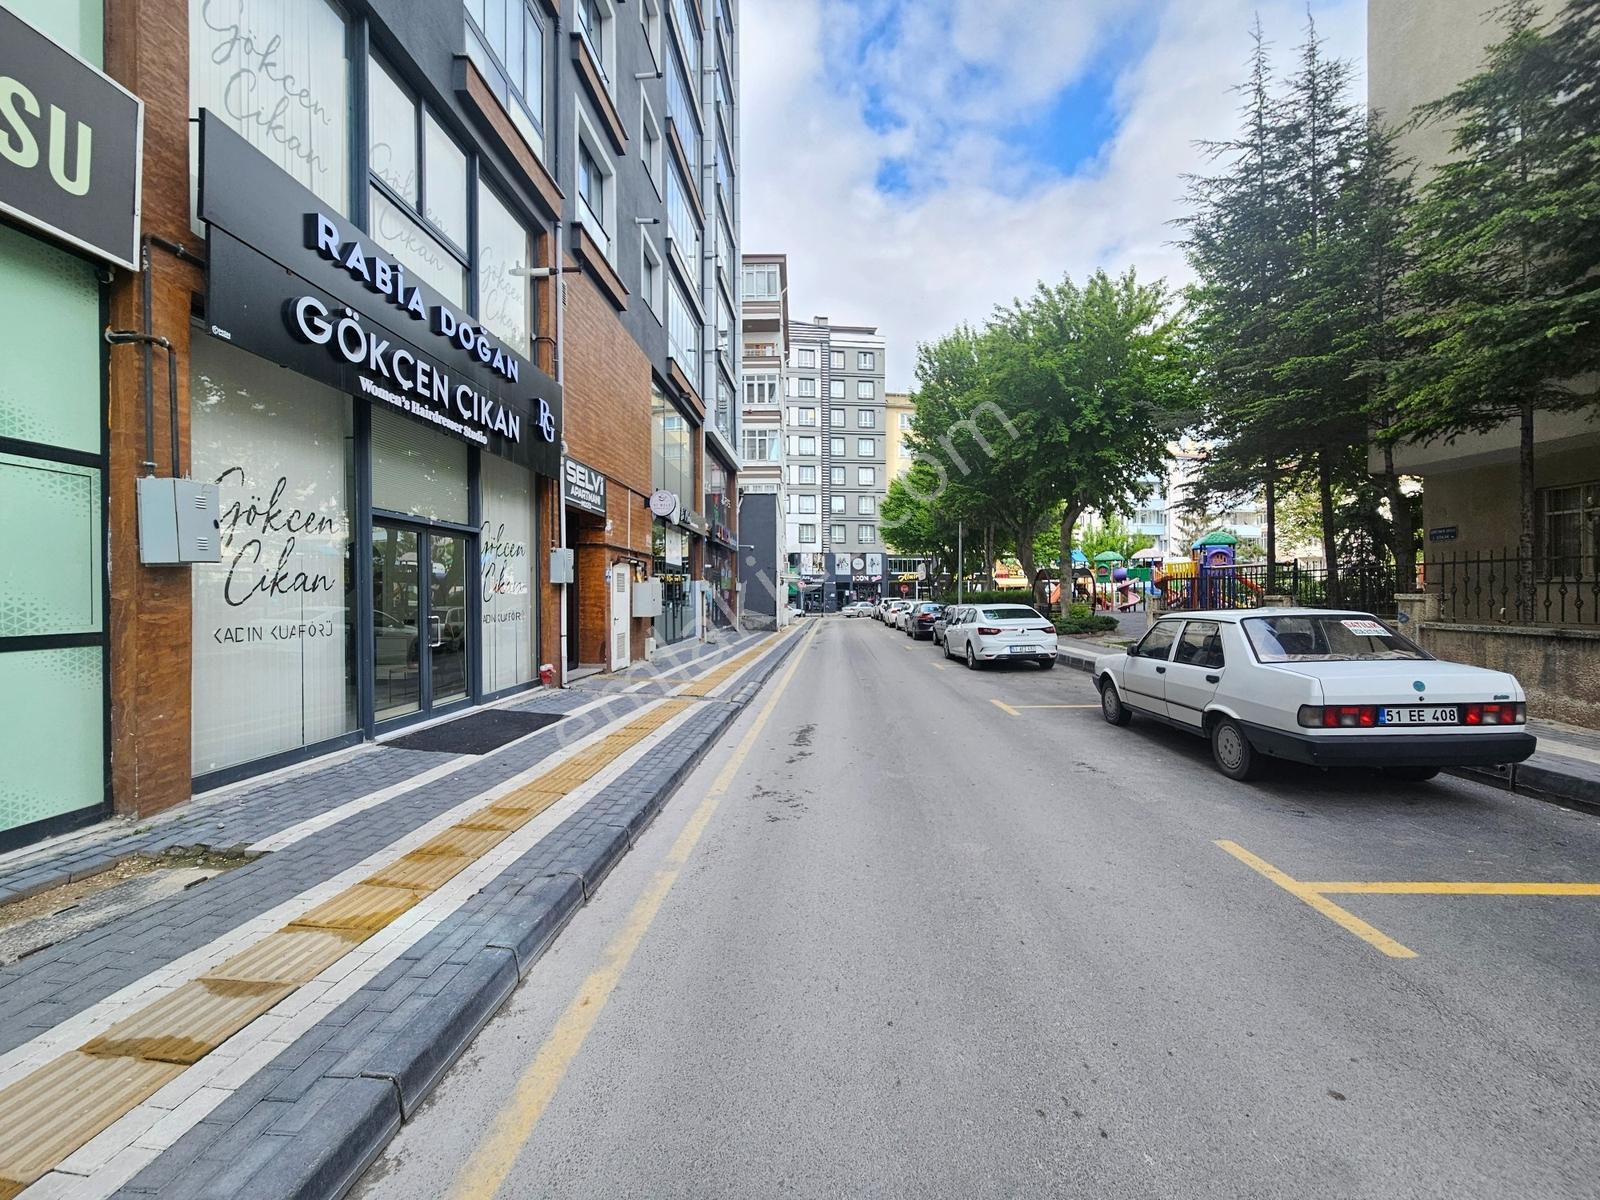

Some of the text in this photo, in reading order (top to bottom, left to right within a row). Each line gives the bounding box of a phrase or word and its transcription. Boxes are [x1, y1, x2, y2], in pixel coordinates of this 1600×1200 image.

[317, 212, 520, 384] RABİA DOĞAN
[296, 296, 520, 443] GÖKÇEN ÇIKAN
[358, 375, 412, 411] Women's
[1386, 709, 1402, 723] 51
[1408, 708, 1426, 722] EE
[1432, 708, 1457, 722] 408
